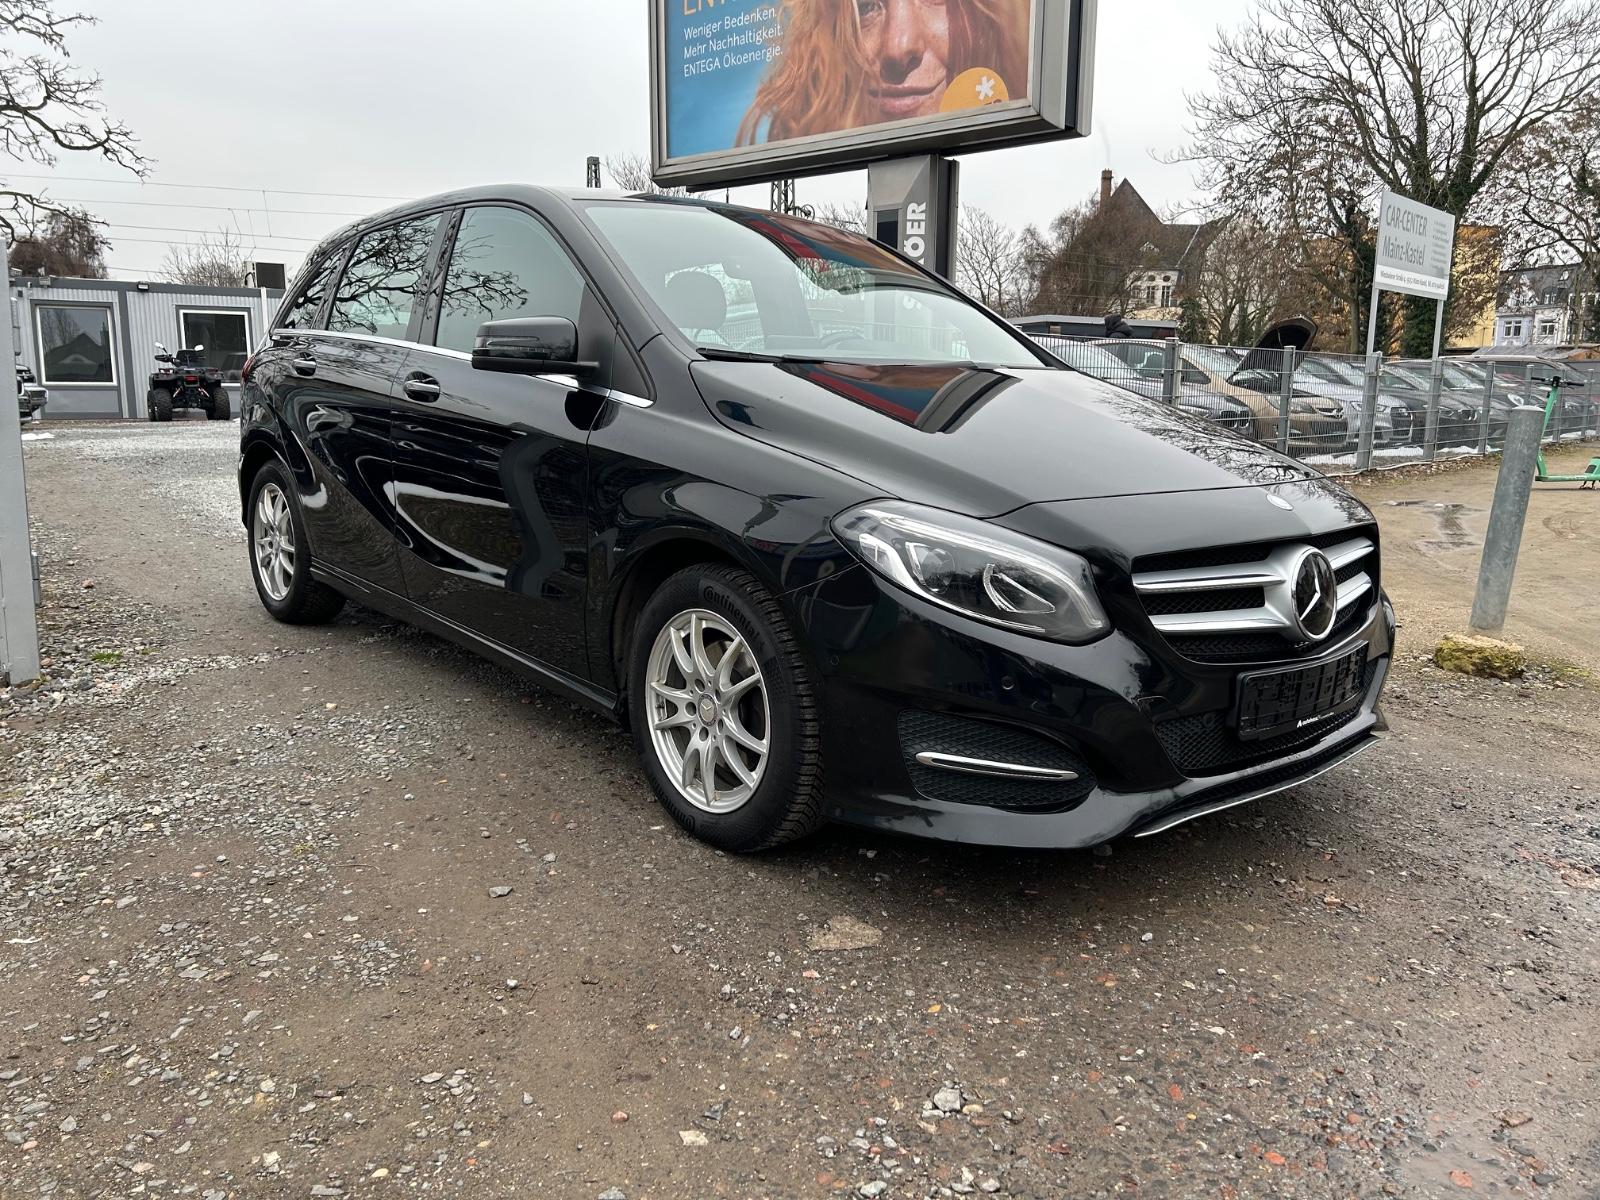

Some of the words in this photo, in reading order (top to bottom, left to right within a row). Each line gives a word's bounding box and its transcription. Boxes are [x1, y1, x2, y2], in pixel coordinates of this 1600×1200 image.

[684, 21, 722, 41] Weniger
[724, 7, 777, 30] Bedenken.
[684, 44, 706, 59] Mehr
[709, 24, 783, 53] Nachhaltigkeit.
[684, 58, 721, 77] ENTEGA
[723, 44, 783, 67] Ökoenergie.
[904, 202, 926, 264] ÖER
[1386, 204, 1428, 237] CAR-CENTER
[1382, 235, 1426, 266] Mainz-Kastel
[703, 586, 760, 641] Continental
